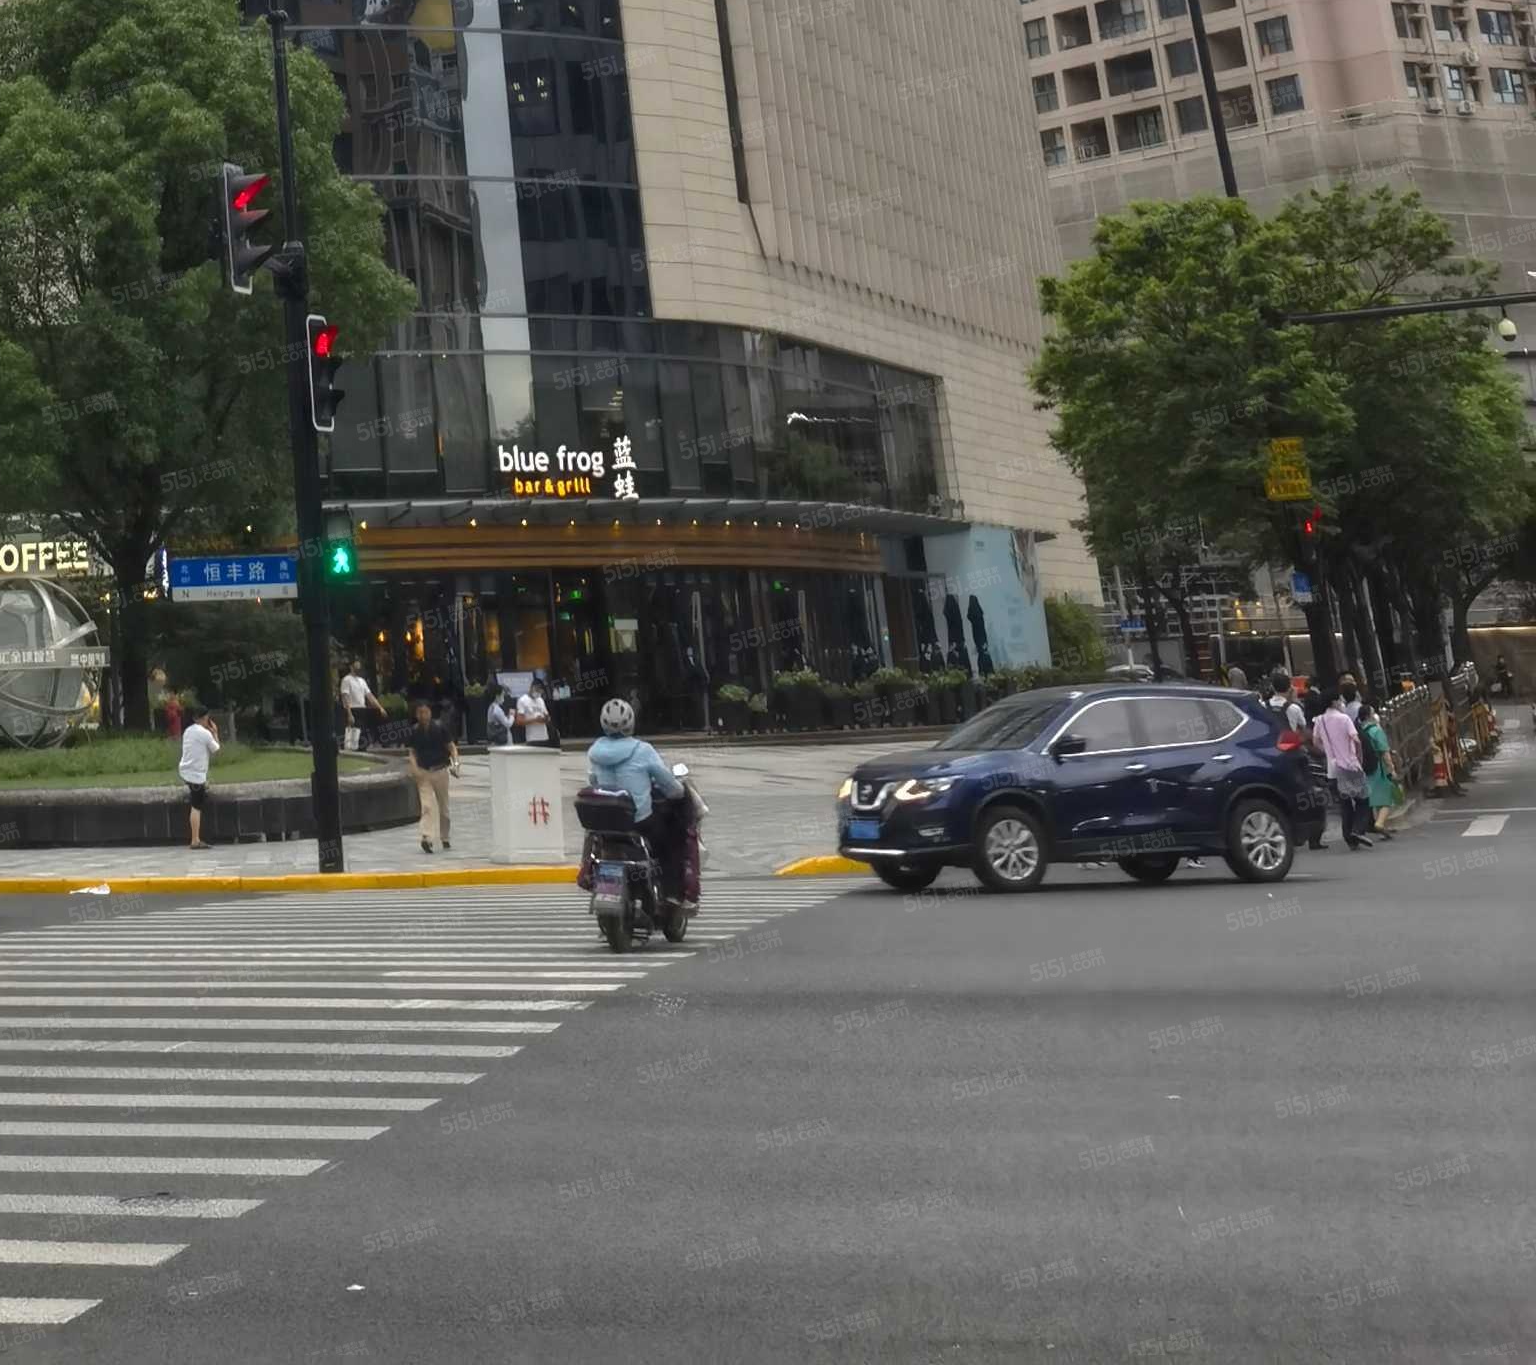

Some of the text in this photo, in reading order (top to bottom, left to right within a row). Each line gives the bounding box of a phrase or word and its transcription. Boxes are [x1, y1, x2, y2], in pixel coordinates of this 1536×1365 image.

[498, 445, 605, 477] blue frog
[612, 435, 640, 501] 蓝蛙
[203, 561, 266, 583] 恒丰路
